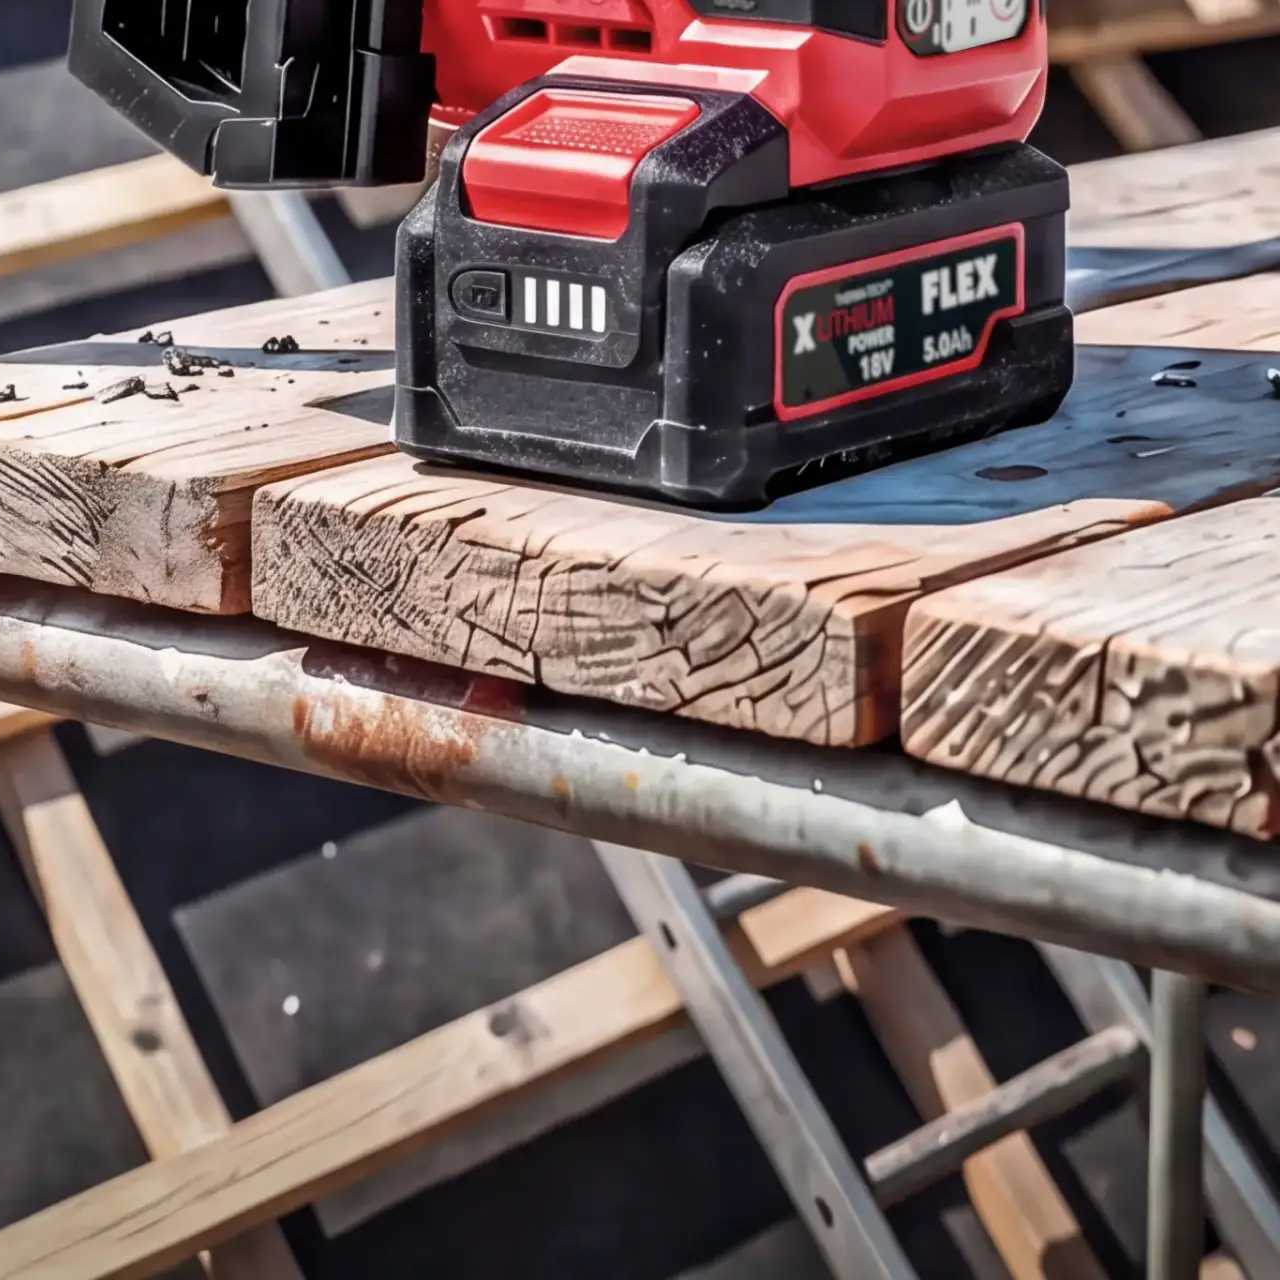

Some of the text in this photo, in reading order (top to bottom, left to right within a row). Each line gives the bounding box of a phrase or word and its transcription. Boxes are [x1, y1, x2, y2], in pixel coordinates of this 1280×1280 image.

[921, 254, 998, 316] FLEX
[848, 325, 895, 355] POWER
[923, 325, 972, 363] 5.0Ah
[859, 348, 895, 381] 18V
